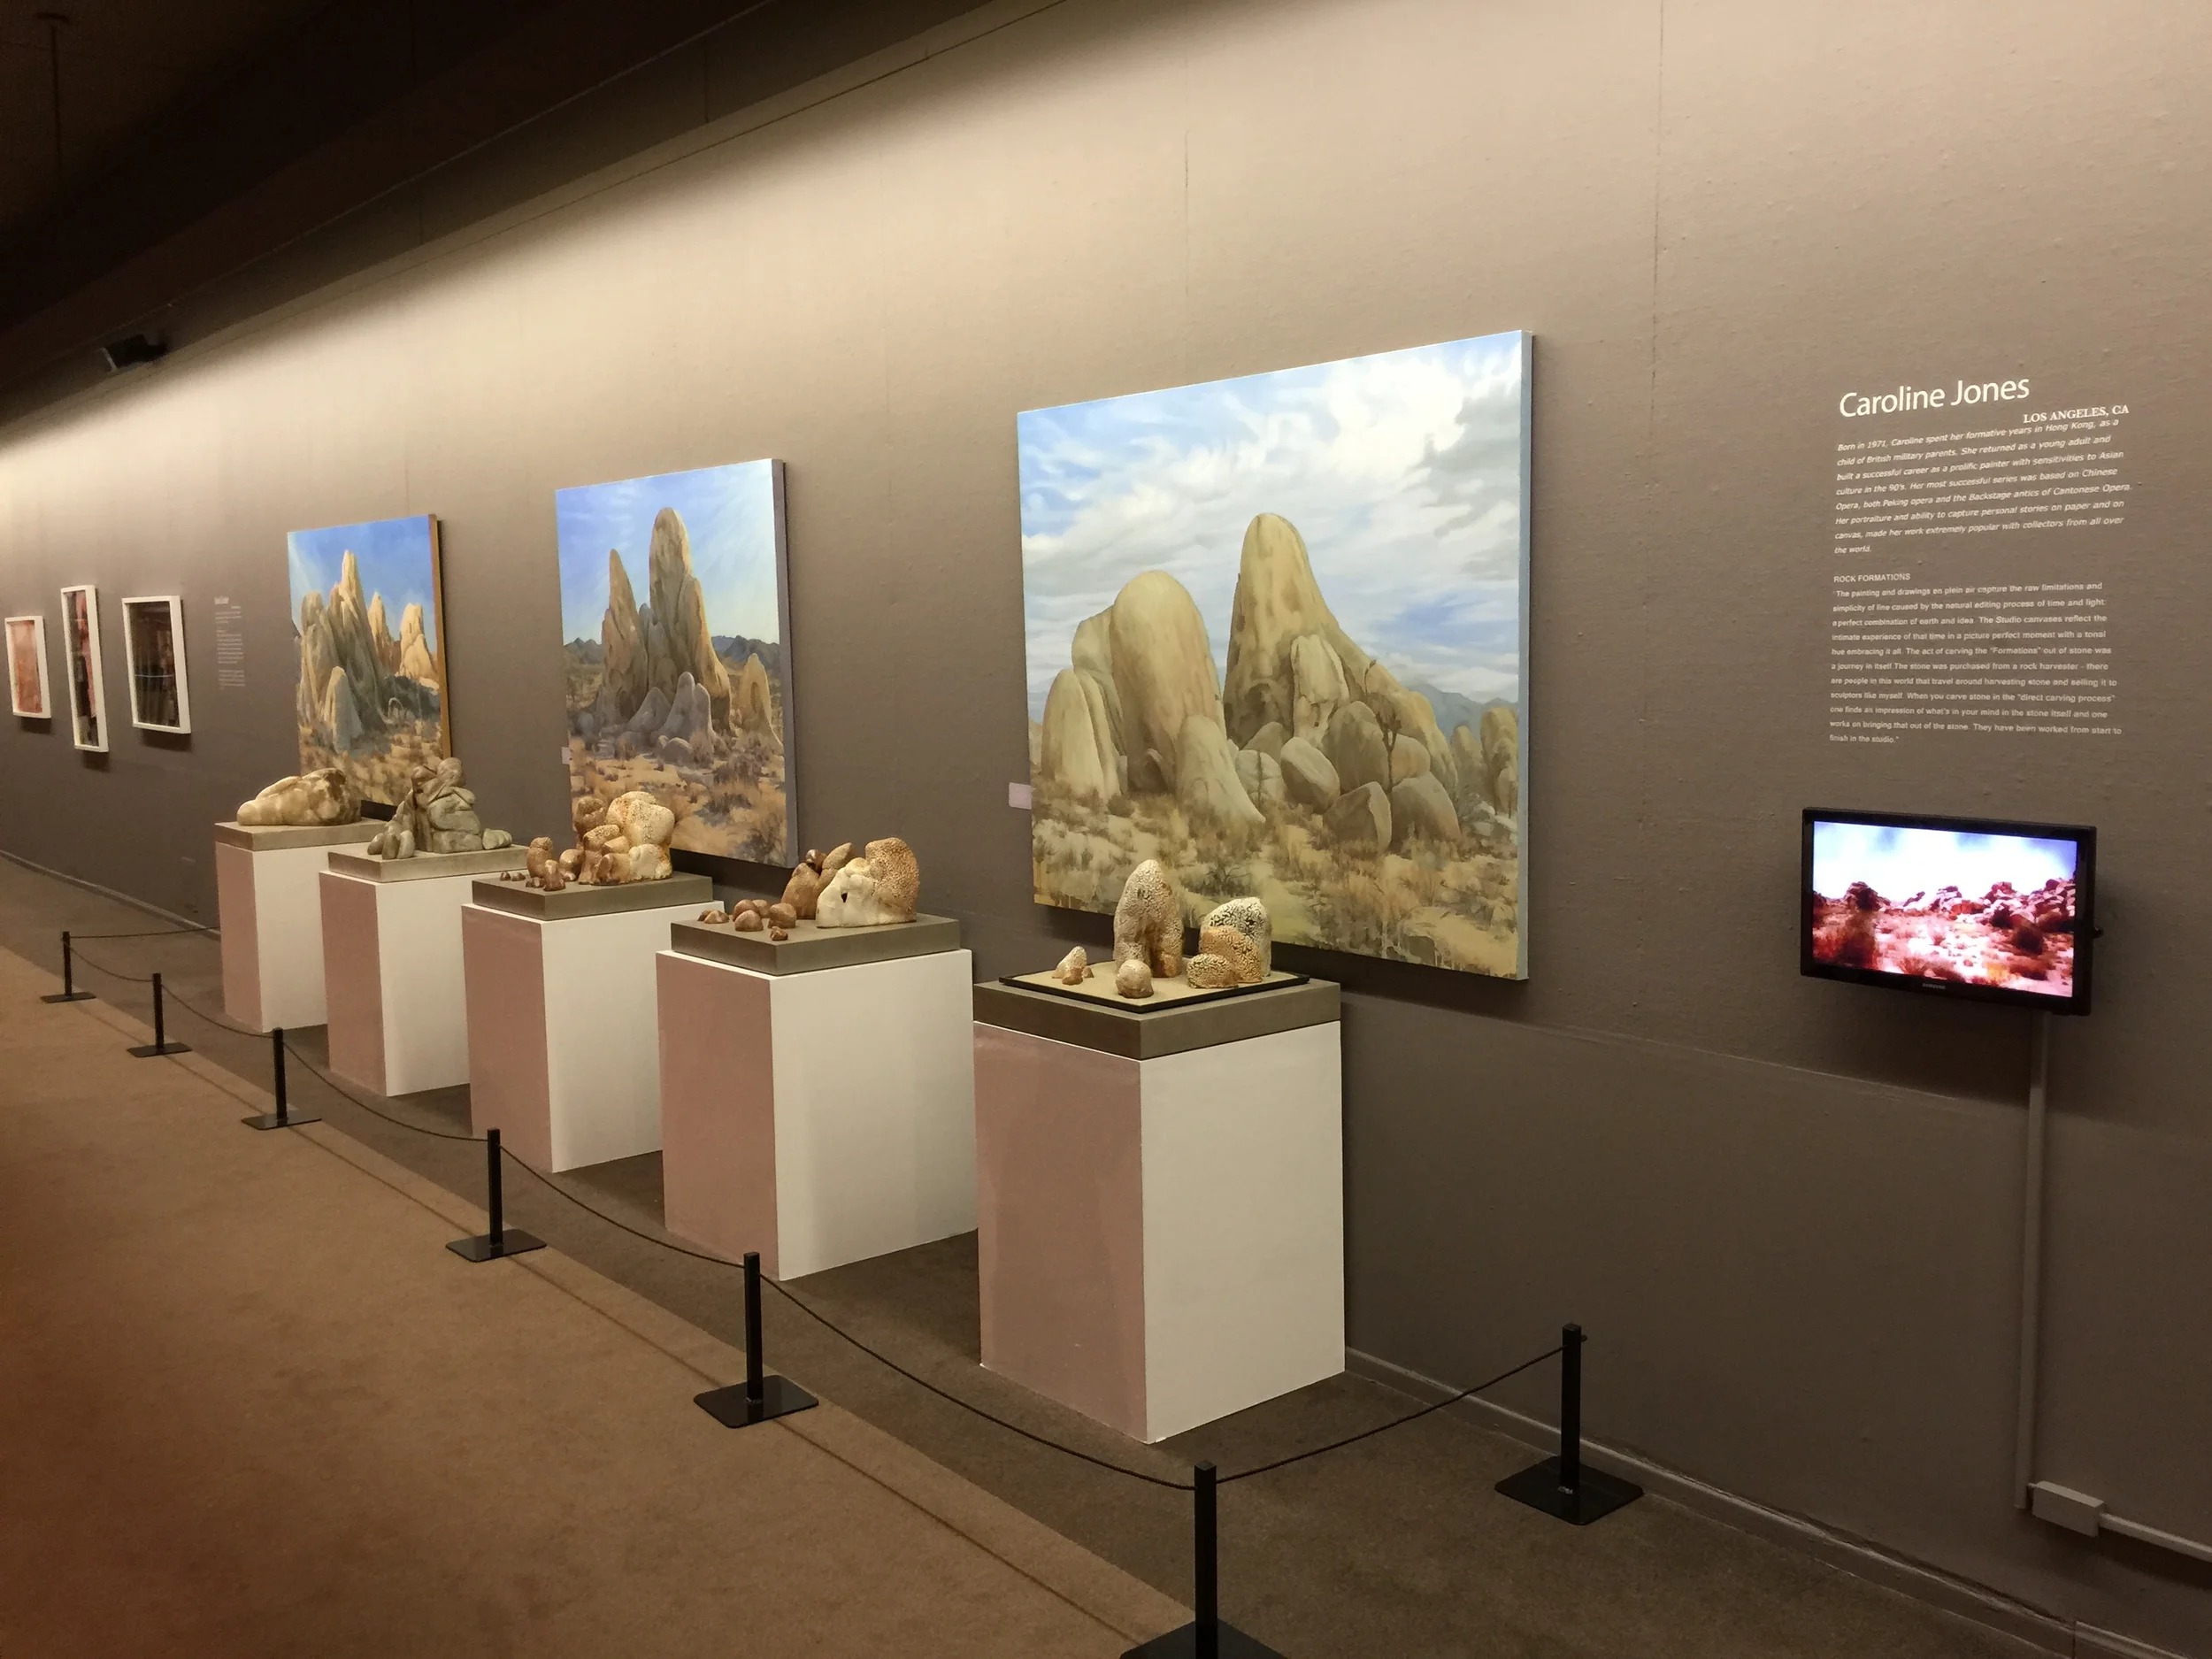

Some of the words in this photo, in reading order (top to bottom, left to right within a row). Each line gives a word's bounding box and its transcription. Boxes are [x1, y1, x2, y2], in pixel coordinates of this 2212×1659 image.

[1839, 386, 1946, 418] Caroline
[1951, 379, 2030, 406] Jones
[2023, 413, 2047, 424] LOS
[2049, 406, 2109, 421] ANGELES,
[2112, 404, 2130, 415] CA
[1891, 436, 1924, 447] Caroline
[1926, 434, 1948, 443] spent
[1950, 432, 1965, 441] her
[1965, 430, 2006, 440] formative
[2008, 426, 2032, 437] years
[2046, 424, 2069, 433] Hong
[1837, 457, 1855, 466] child
[1867, 455, 1892, 464] British
[1893, 452, 1924, 461] military
[1979, 443, 2016, 454] returned
[2039, 440, 2066, 449] young
[2068, 437, 2091, 446] adult
[2093, 435, 2112, 444] and
[1863, 469, 1902, 480] successful
[1950, 462, 1978, 472] prolific
[1979, 460, 2011, 470] painter
[2033, 454, 2085, 465] sensitivities
[2099, 451, 2124, 460] Asian
[1836, 487, 1863, 495] culture
[1874, 484, 1887, 493] the
[1948, 477, 1991, 487] successful
[1993, 475, 2018, 484] series
[2040, 472, 2067, 480] based
[2082, 468, 2118, 478] Chinese
[1863, 500, 1881, 509] both
[1883, 498, 1909, 508] Peking
[1910, 497, 1934, 507] opera
[1969, 491, 2011, 501] Backstage
[2014, 489, 2039, 498] antics
[2053, 486, 2101, 495] Cantonese
[1910, 512, 1935, 521] ability
[1948, 510, 1979, 518] capture
[1981, 506, 2018, 517] personal
[2020, 504, 2049, 513] stories
[2064, 503, 2091, 512] paper
[2093, 500, 2111, 509] and
[1926, 526, 1967, 534] extremely
[1968, 524, 2001, 533] popular
[2023, 519, 2064, 529] collectors
[1858, 573, 1911, 582] FORMATIONS
[1851, 589, 1880, 598] painting
[1898, 588, 1931, 597] drawings
[1978, 586, 2008, 595] capture
[1985, 678, 2026, 687] harvesting
[2046, 695, 2076, 703] carving
[1973, 723, 1993, 732] They
